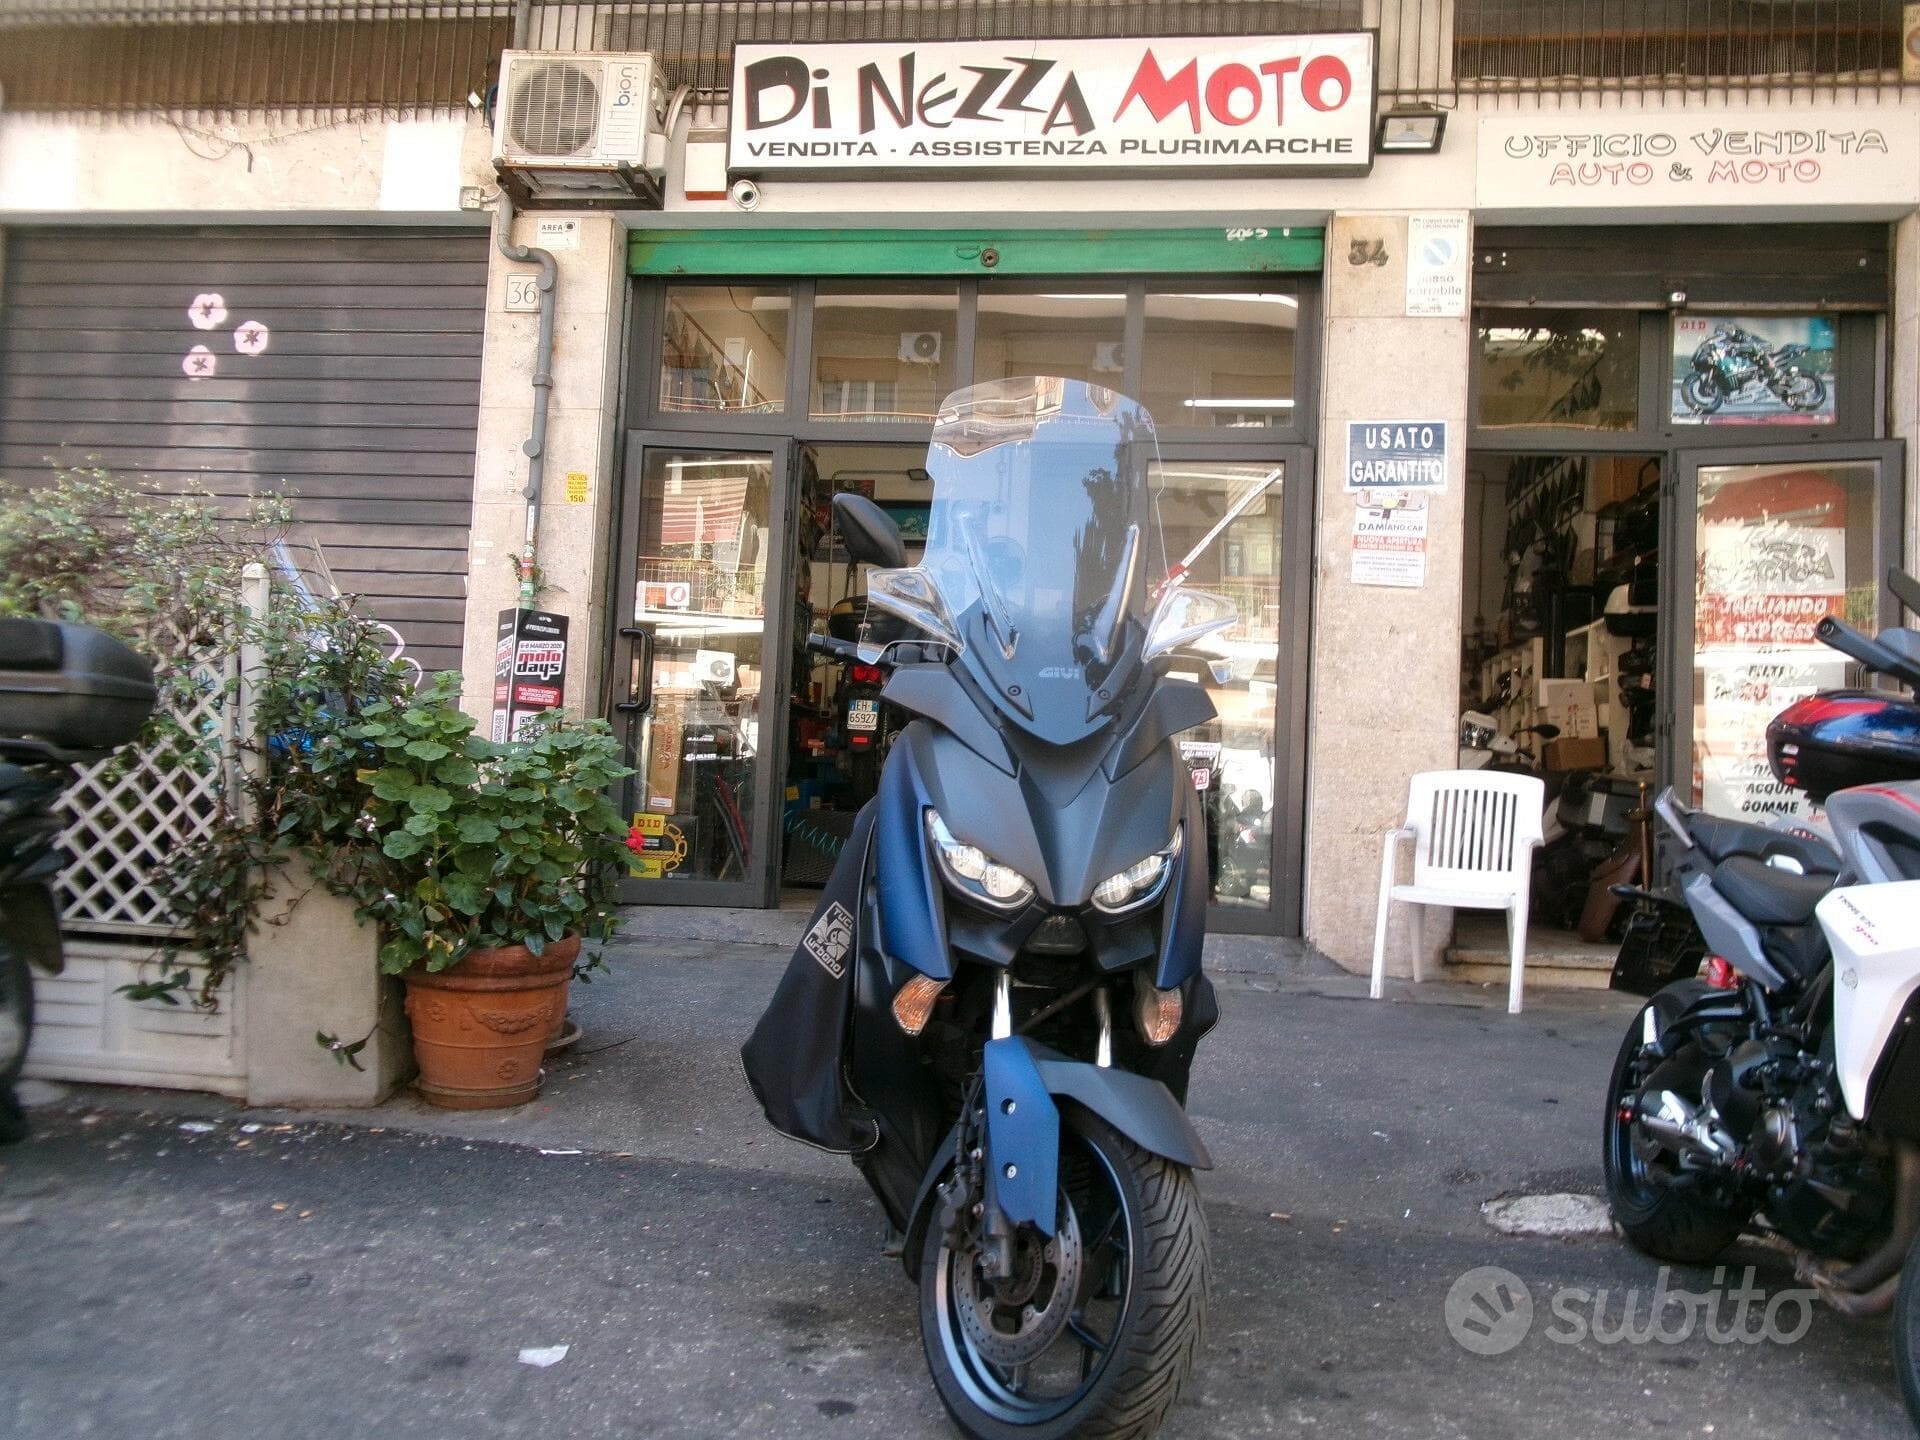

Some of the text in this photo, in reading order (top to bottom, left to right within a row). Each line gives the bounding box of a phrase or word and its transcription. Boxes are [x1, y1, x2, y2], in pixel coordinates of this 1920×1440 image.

[744, 47, 1352, 136] Di NEZZA MOTO
[747, 141, 876, 157] VENDITA
[908, 139, 1108, 156] ASSISTENZA
[1119, 137, 1353, 154] PLURIMARCHE
[1504, 128, 1889, 159] UFFICIO VENDITA
[1550, 160, 1821, 186] AUTO & MOTO
[509, 281, 537, 304] 36
[1365, 427, 1434, 450] USATO
[1351, 459, 1443, 483] GARANTITO
[517, 662, 560, 678] days
[1039, 666, 1080, 679] GIVI
[1746, 783, 1794, 795] ACQUA
[1742, 802, 1799, 814] GOMME
[808, 937, 842, 973] urbano
